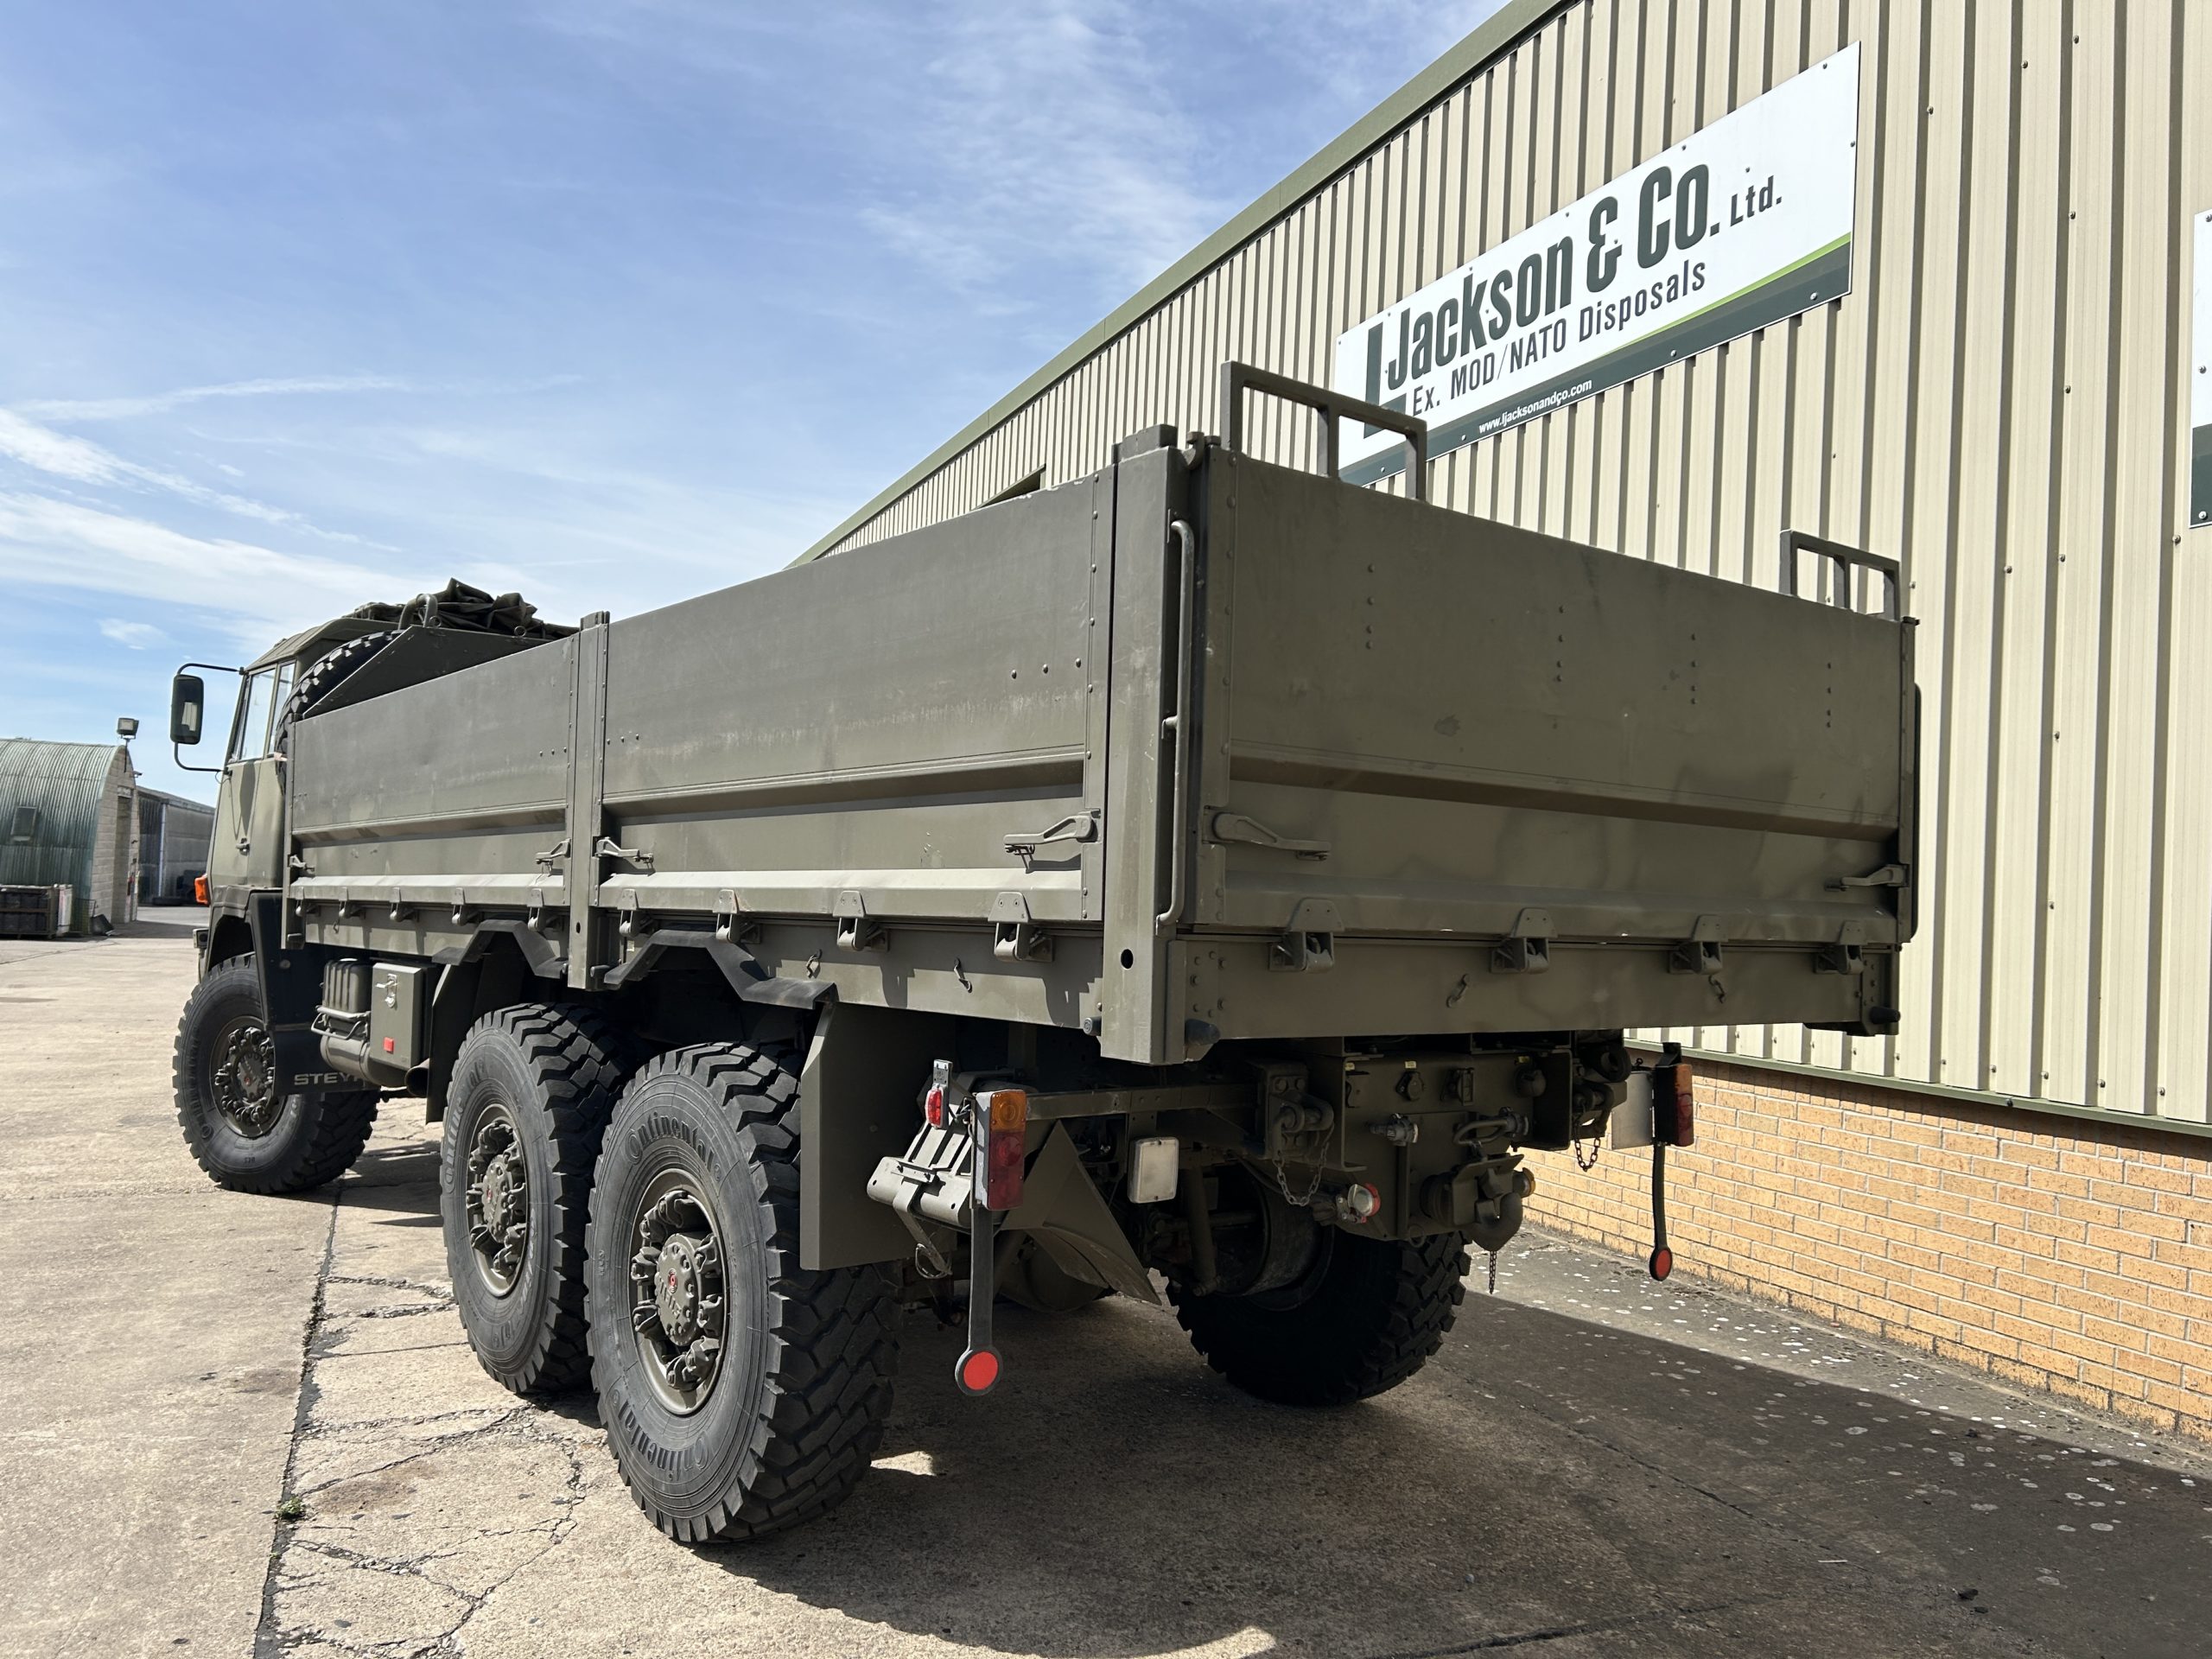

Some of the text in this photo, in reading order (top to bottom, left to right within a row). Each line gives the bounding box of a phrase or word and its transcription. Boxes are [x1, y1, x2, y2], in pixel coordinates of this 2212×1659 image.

[1388, 236, 1573, 391] Jackson
[1586, 196, 1622, 292] &
[1637, 164, 1720, 269] Co.
[1730, 176, 1783, 227] Ltd.
[1413, 262, 1706, 416] Ex. MOD/NATO Disposals
[295, 1072, 358, 1085] STEY
